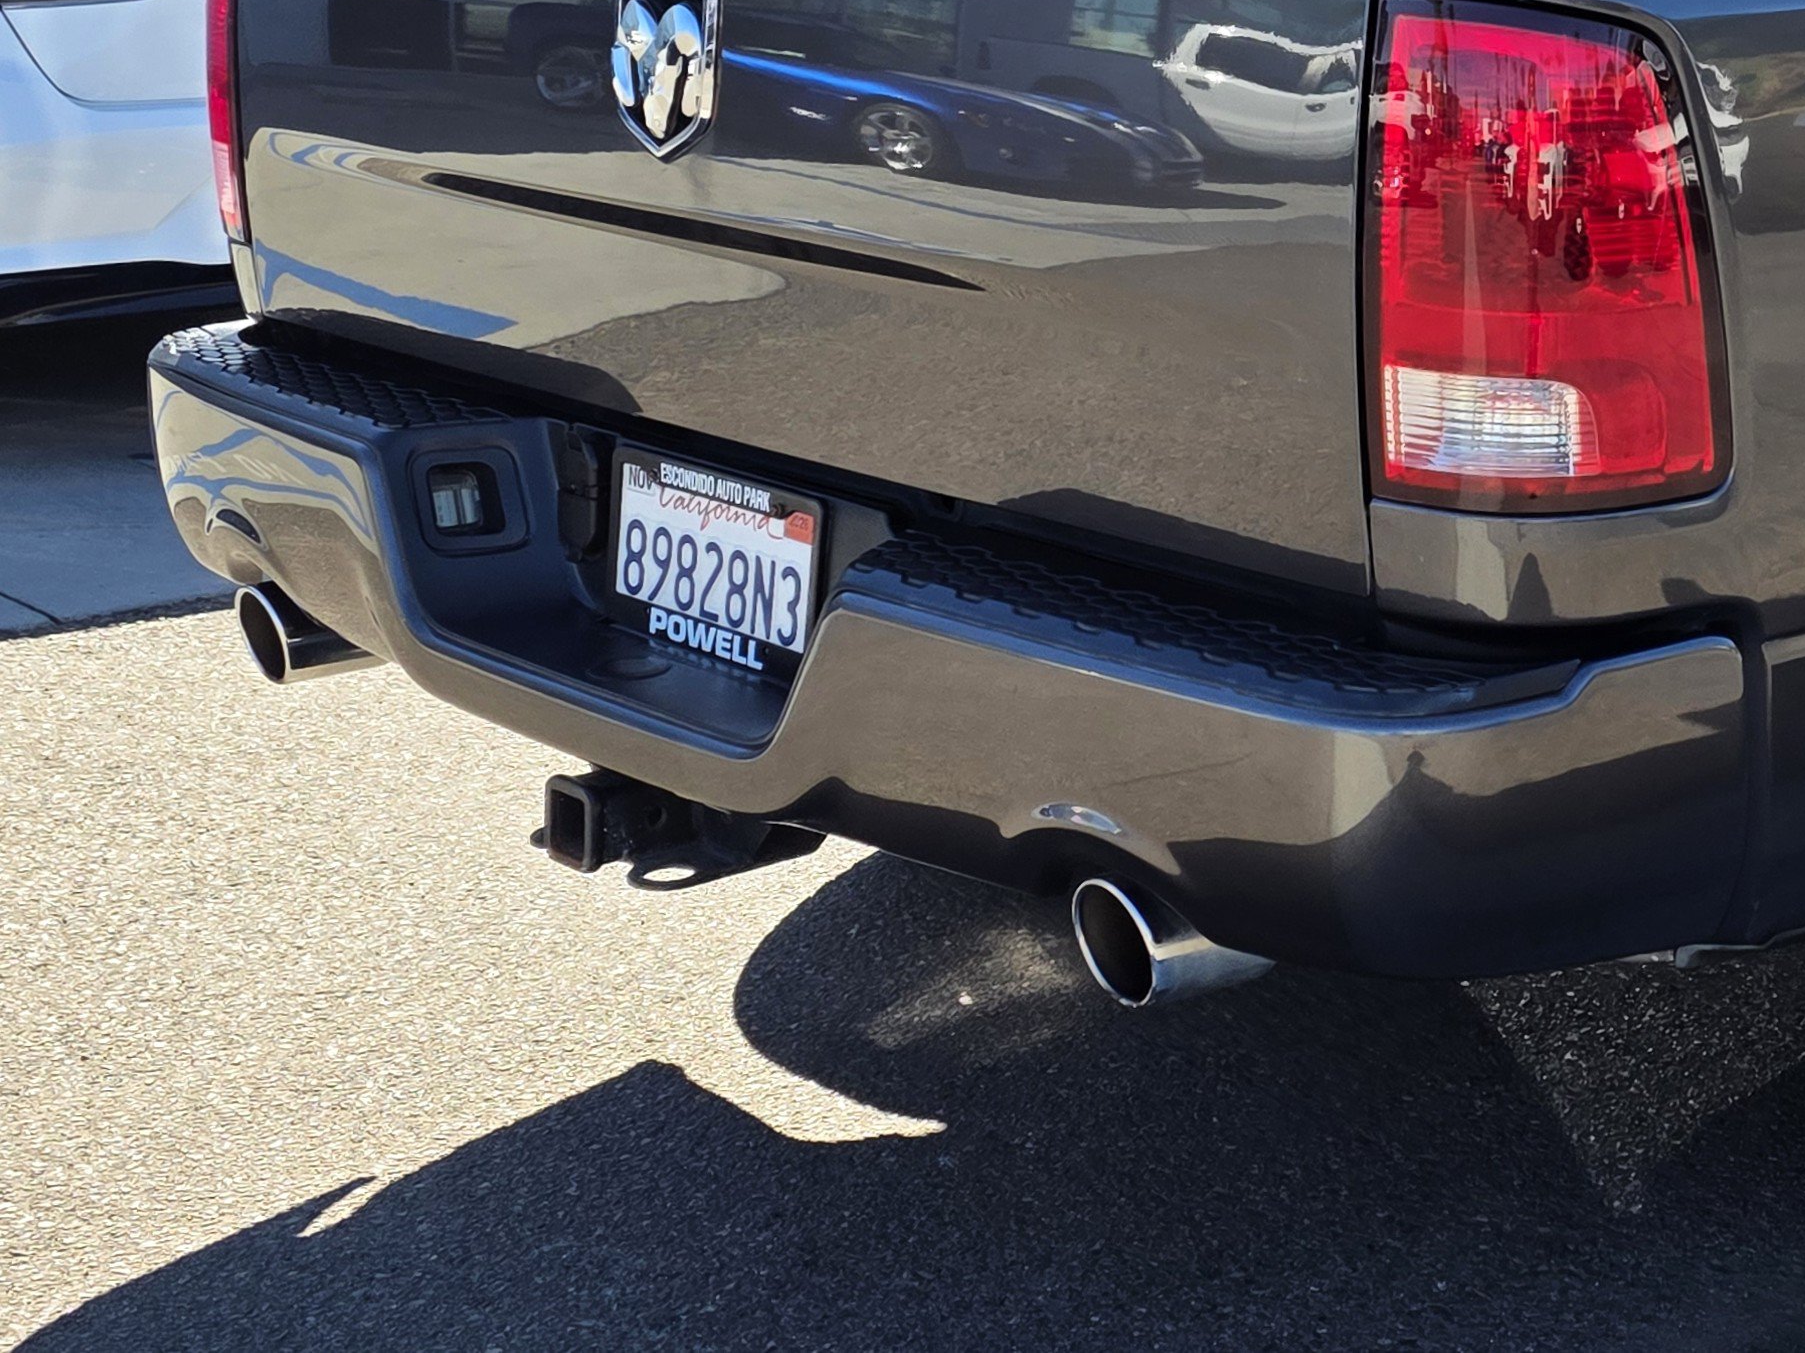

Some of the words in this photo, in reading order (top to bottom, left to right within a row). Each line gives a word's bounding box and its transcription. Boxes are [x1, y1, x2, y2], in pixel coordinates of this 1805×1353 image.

[660, 462, 715, 495] ESCONDIDO
[716, 479, 742, 505] AUTO
[743, 486, 770, 513] PARK
[623, 519, 801, 647] 89828N3
[649, 607, 763, 671] POWELL
